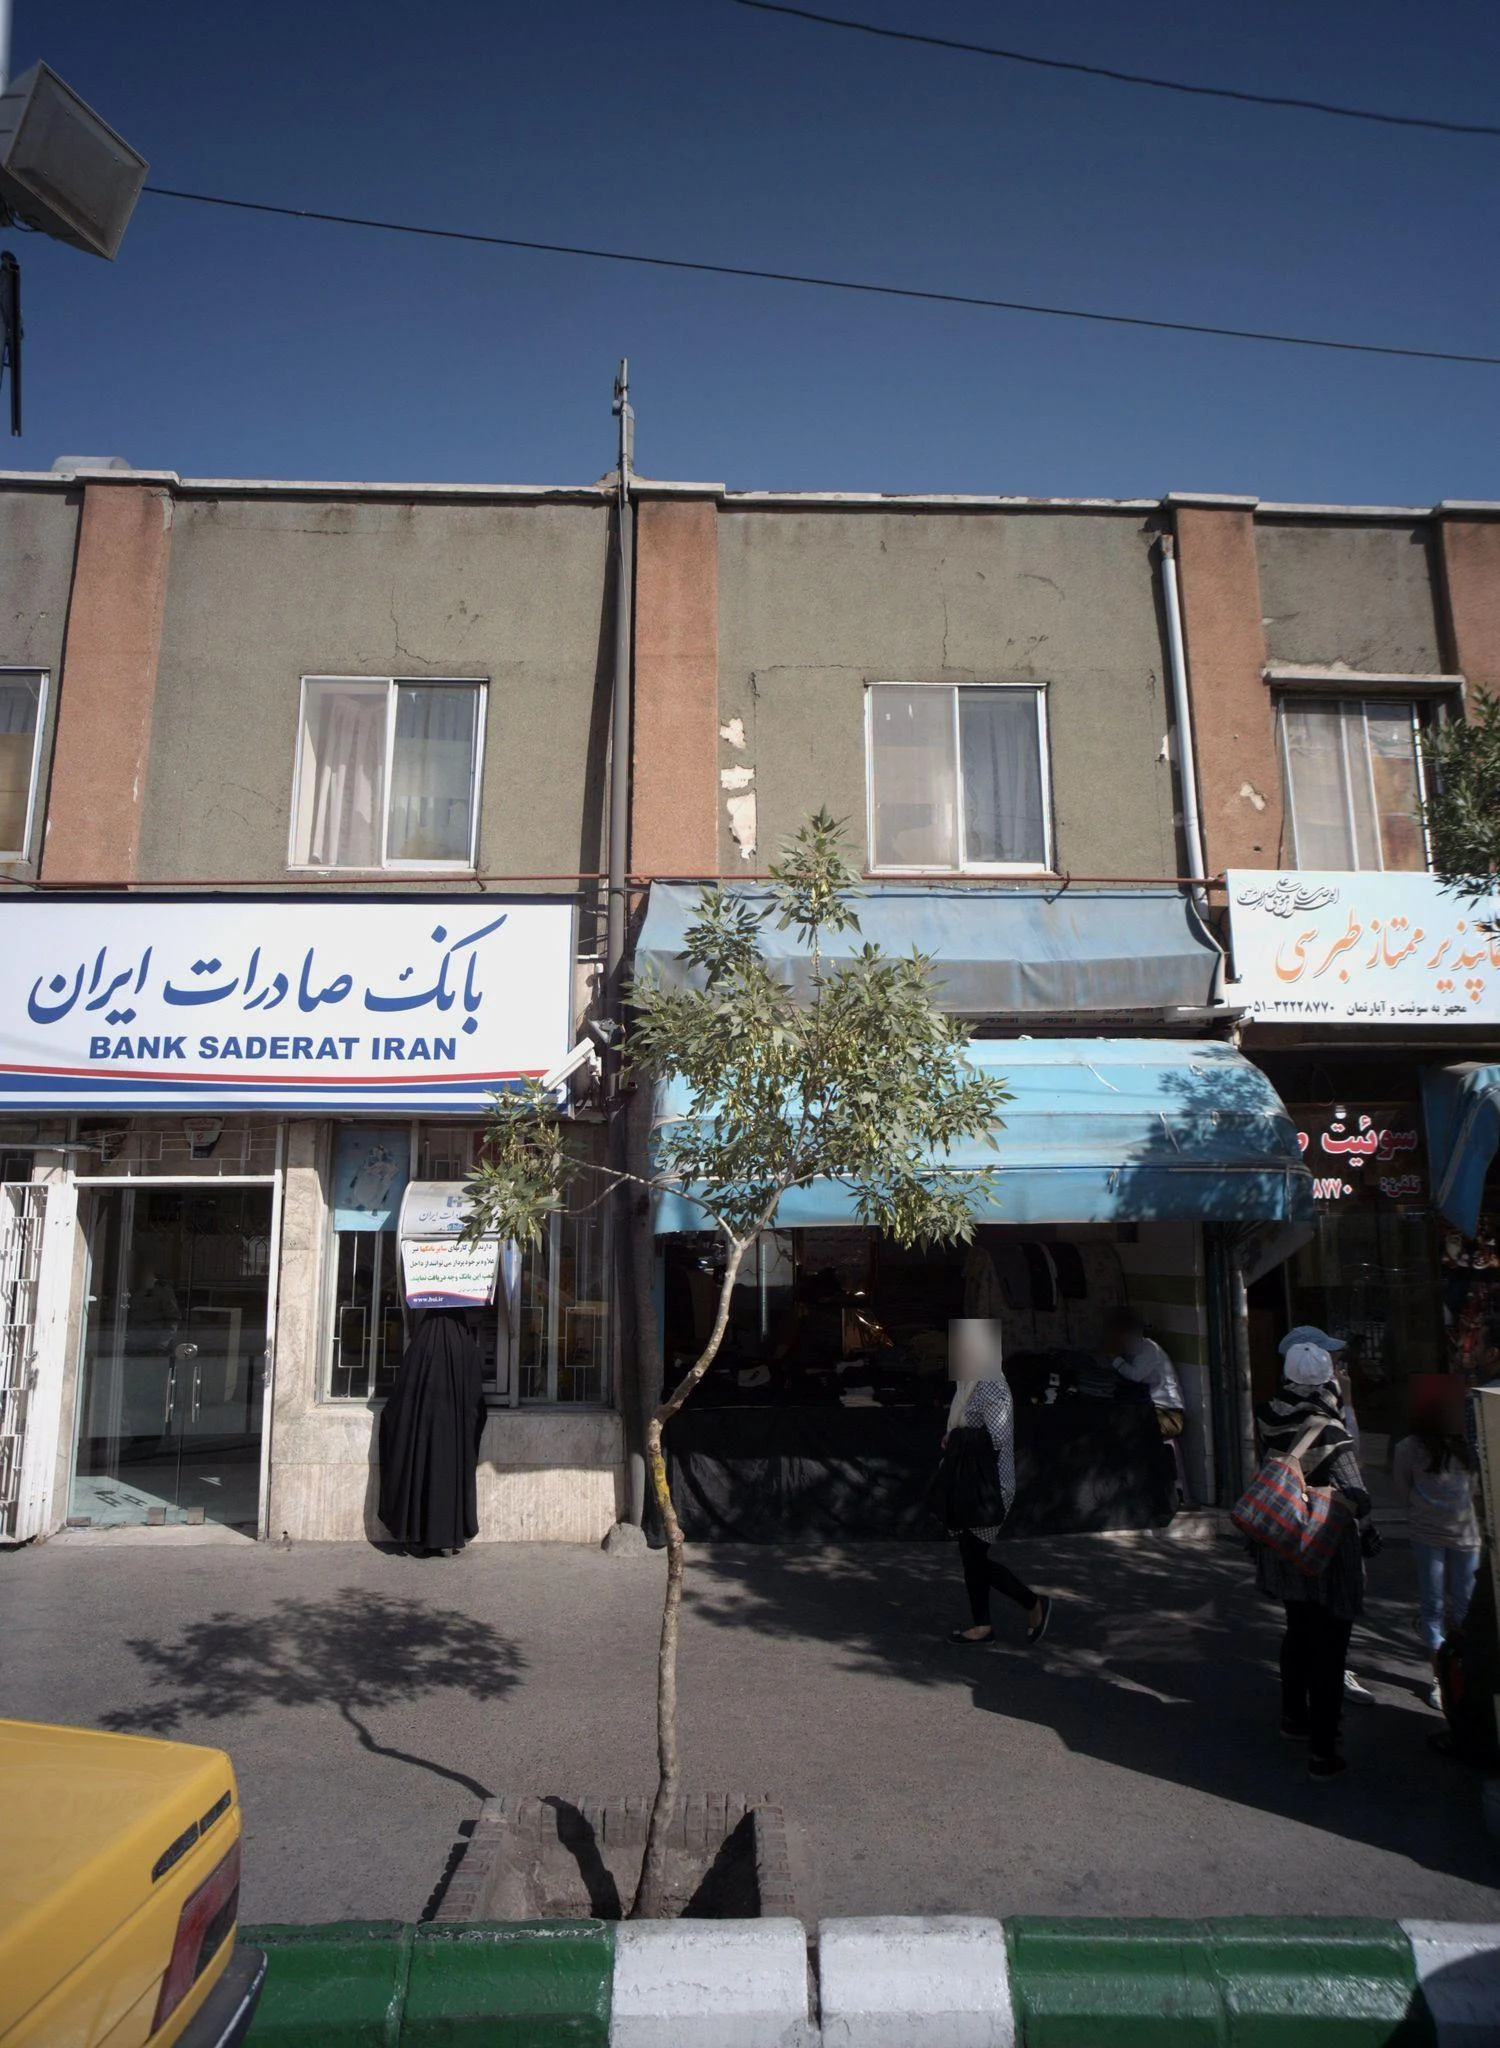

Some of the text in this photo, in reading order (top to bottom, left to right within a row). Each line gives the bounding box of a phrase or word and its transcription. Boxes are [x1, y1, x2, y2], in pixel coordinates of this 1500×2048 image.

[1275, 907, 1363, 984] طبرسی
[1367, 916, 1425, 970] ممتاز
[27, 914, 508, 1034] بانک صادرات ایران
[1346, 1000, 1387, 1017] آپارتمان
[1391, 1006, 1396, 1016] و
[1431, 1004, 1441, 1015] به
[1444, 1002, 1468, 1017] مجهز
[89, 1035, 457, 1061] BANK SADERAT IRAN
[1321, 1114, 1418, 1168] سوئیت
